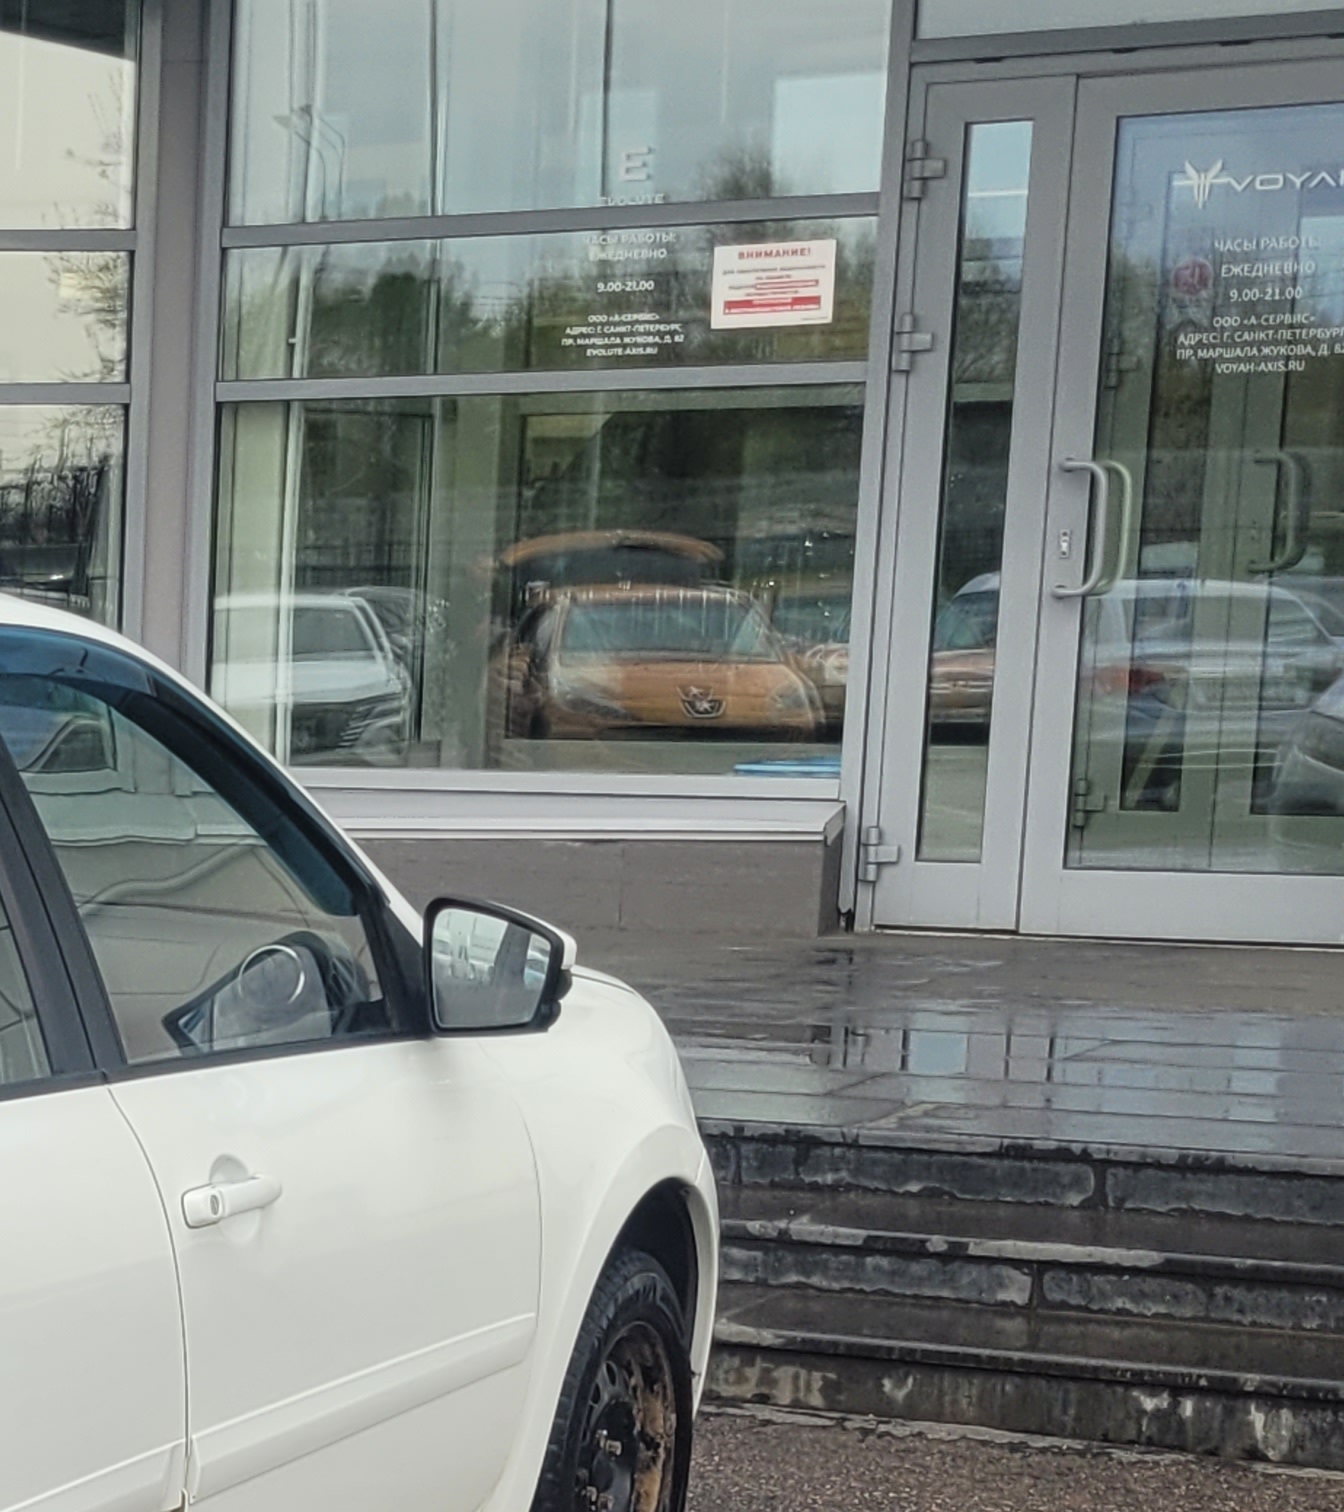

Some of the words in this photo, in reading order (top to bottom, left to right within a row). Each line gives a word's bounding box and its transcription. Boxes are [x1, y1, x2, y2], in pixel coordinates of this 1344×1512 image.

[1227, 170, 1344, 192] VOYA
[1214, 237, 1257, 252] ЧАСЫ
[738, 247, 811, 260] ВНИМАНИЕ!
[1221, 261, 1316, 278] ЕЖЕДНЕВНО
[596, 280, 655, 293] 9.00-21.00
[1229, 285, 1303, 302] 9.00-21.00
[1213, 316, 1241, 328] ООО
[1197, 346, 1259, 359] МАРШАЛА
[1215, 360, 1306, 375] VOYAH-AXIS.RU
